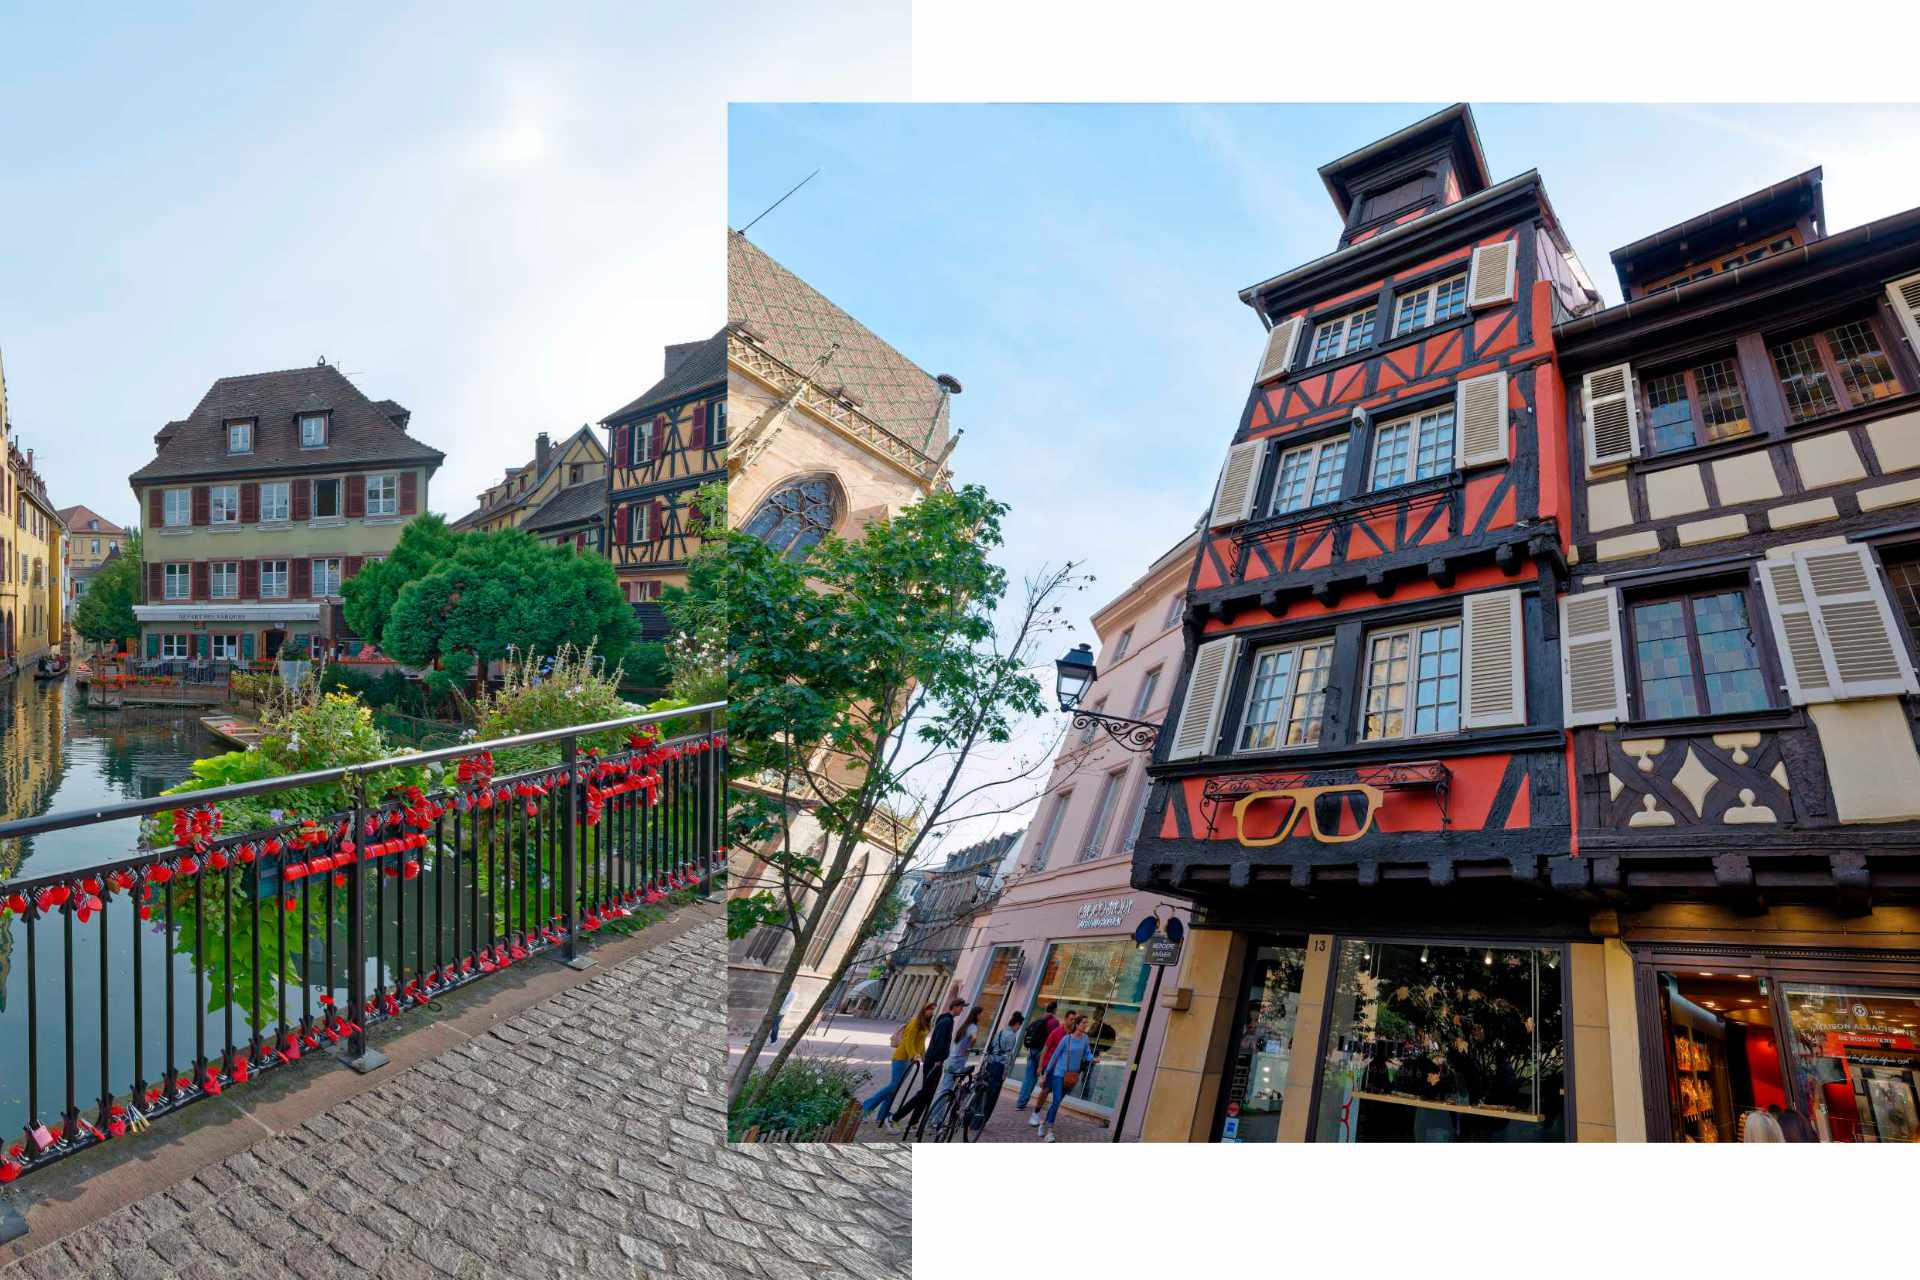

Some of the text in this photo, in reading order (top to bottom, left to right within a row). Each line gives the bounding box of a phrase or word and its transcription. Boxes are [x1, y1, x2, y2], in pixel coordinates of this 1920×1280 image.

[1315, 940, 1326, 952] 13
[1813, 1023, 1917, 1038] MAISON ALSACIENNE
[1850, 1036, 1897, 1044] BISCUITERIE
